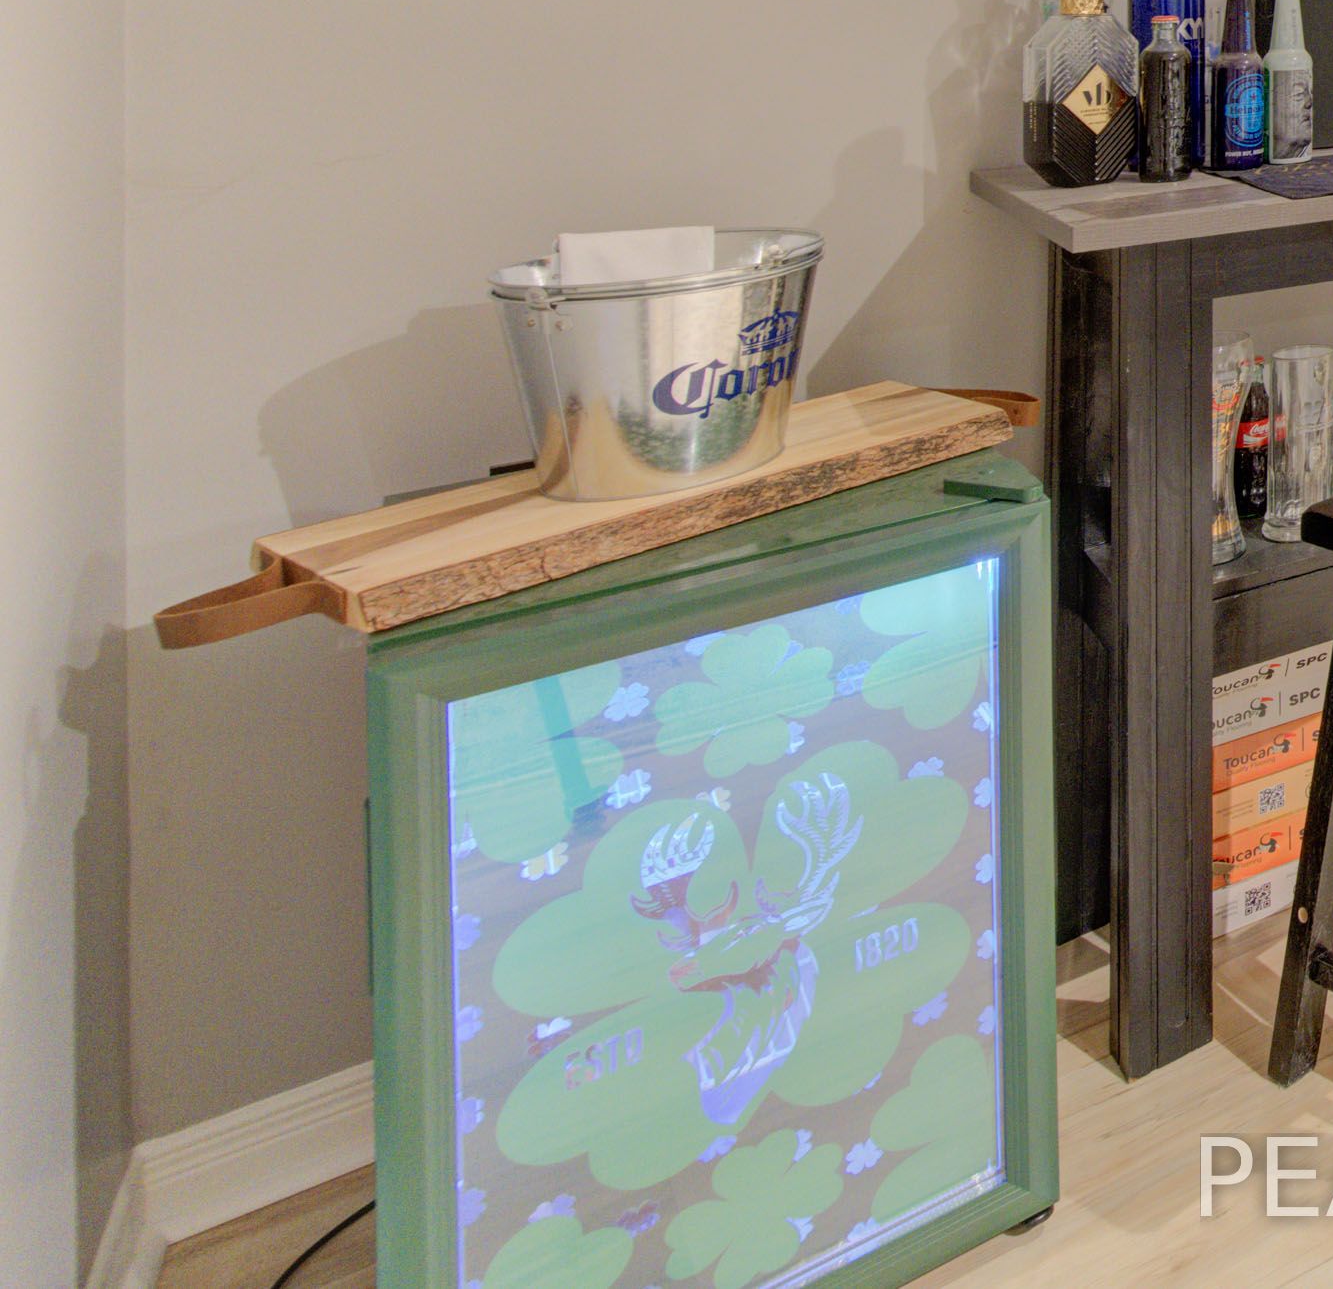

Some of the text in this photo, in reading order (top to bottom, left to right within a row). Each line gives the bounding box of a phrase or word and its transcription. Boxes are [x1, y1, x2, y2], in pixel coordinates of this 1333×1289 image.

[1296, 652, 1328, 670] SPC
[1212, 688, 1320, 730] ucan SPC
[1224, 746, 1274, 770] Toucan
[854, 917, 920, 974] 1820
